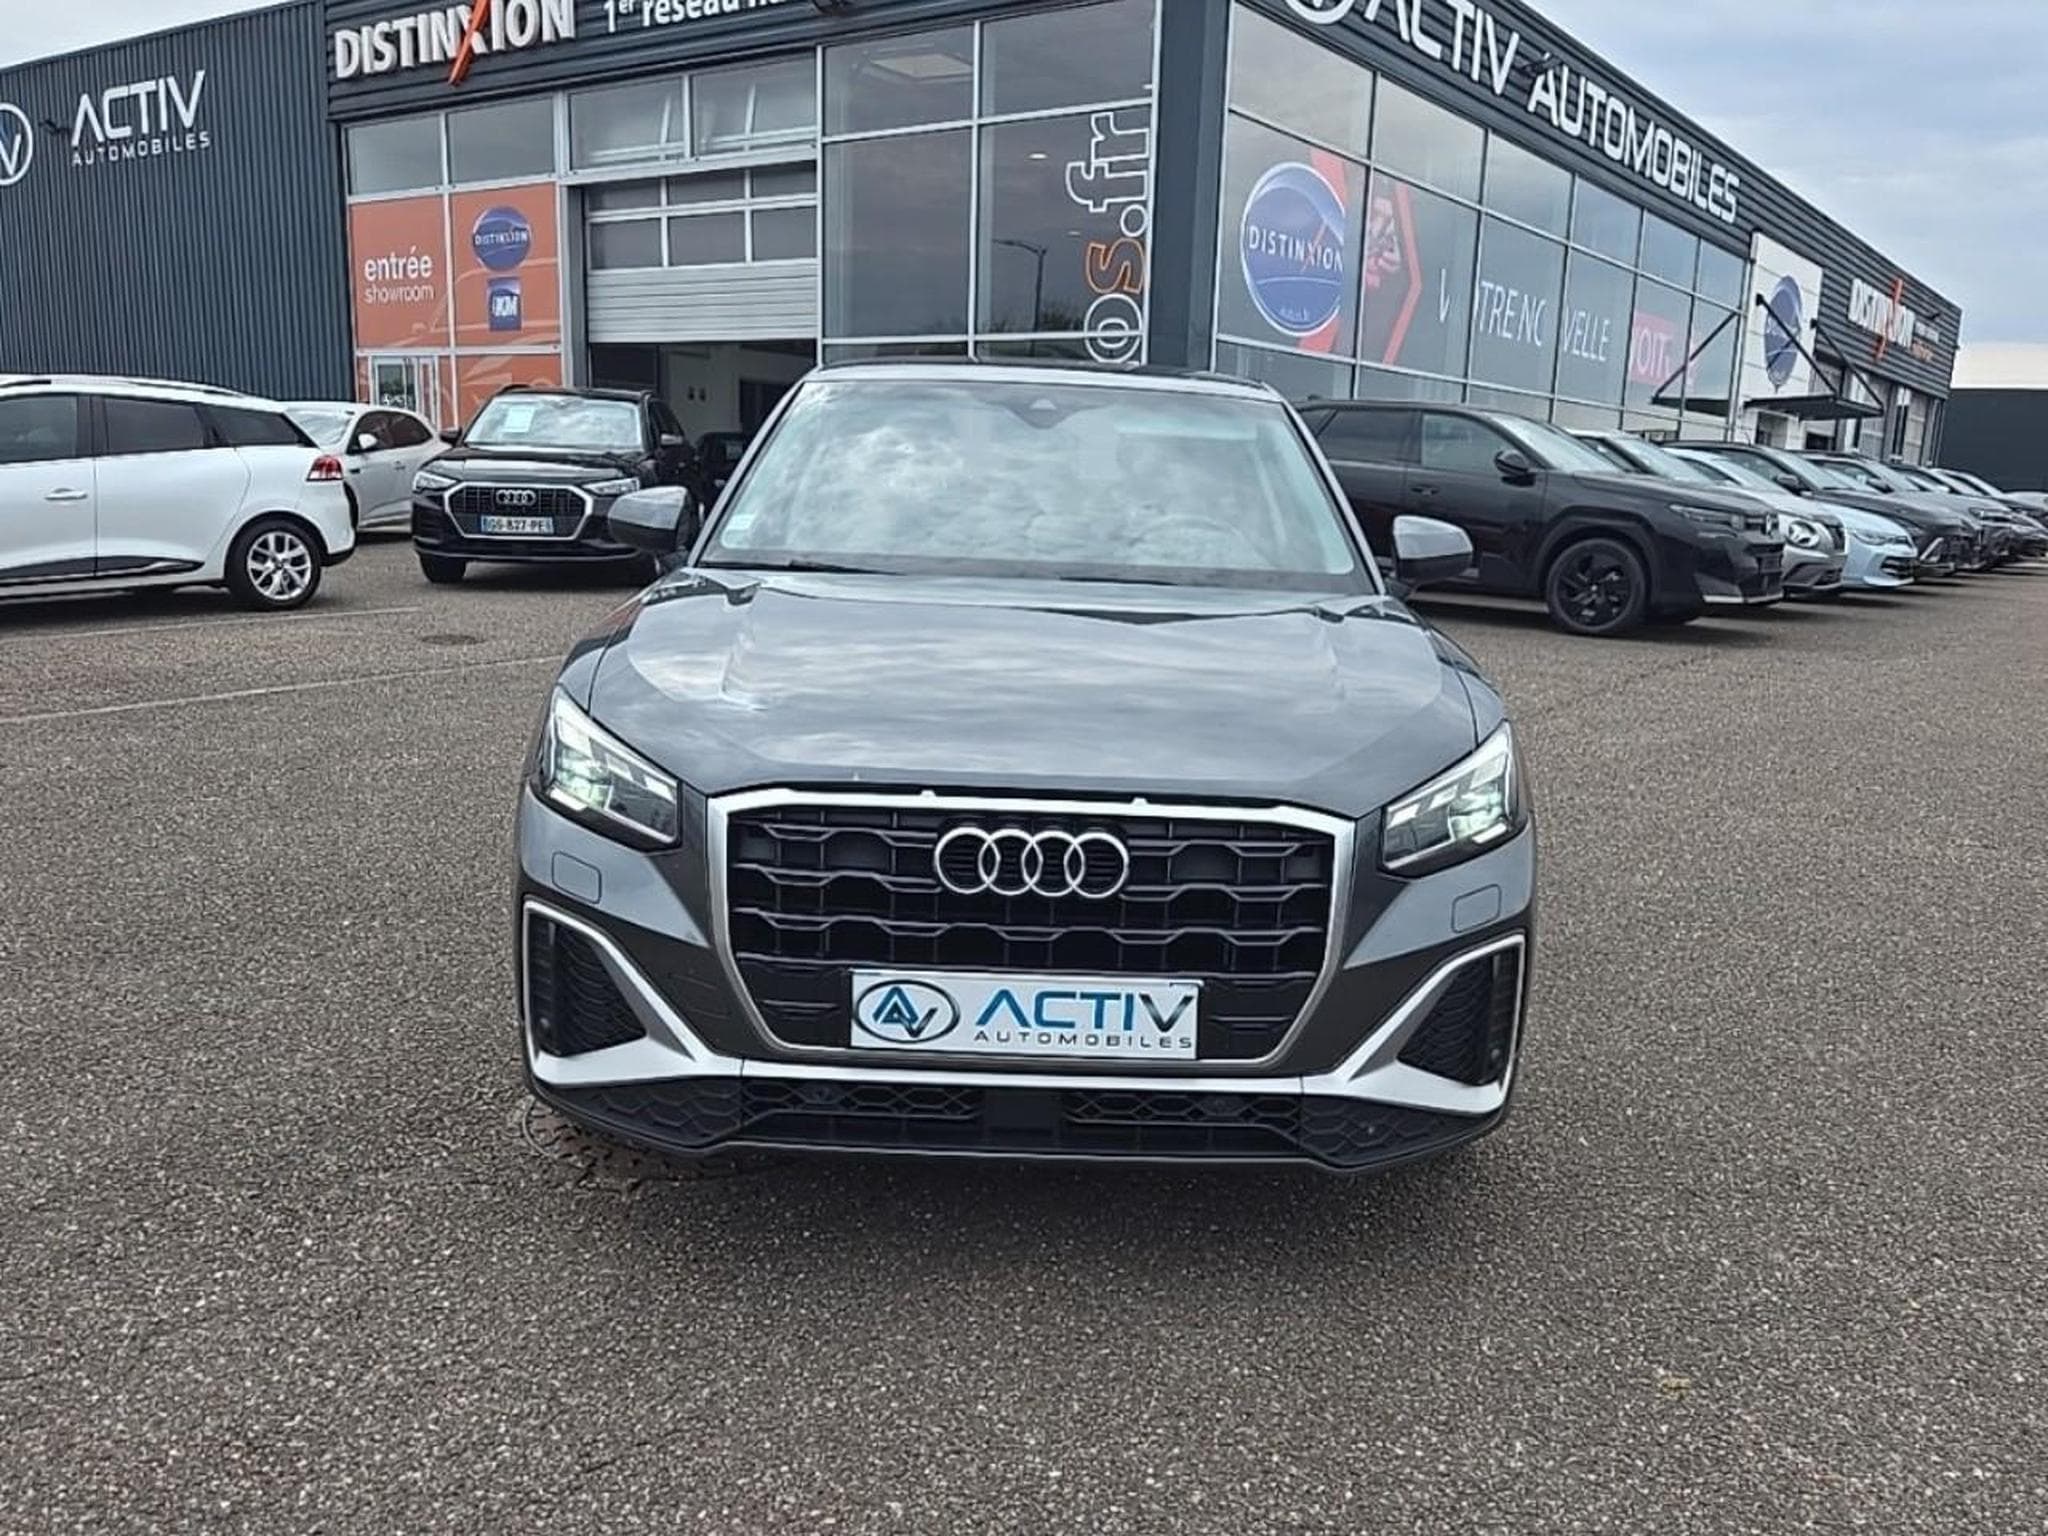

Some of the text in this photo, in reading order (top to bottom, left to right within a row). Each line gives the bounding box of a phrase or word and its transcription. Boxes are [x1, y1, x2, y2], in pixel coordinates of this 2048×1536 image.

[334, 0, 577, 84] DISTINXION
[71, 70, 205, 147] ACTIV
[72, 131, 210, 167] AUTOMOBILES
[1528, 62, 1740, 223] AUTOMOBILES
[364, 246, 433, 281] entrée
[1249, 222, 1344, 274] DISTINXION
[365, 283, 434, 304] showroom
[975, 989, 1195, 1033] ACTIV
[974, 1030, 1193, 1049] AUTOMOBILES
